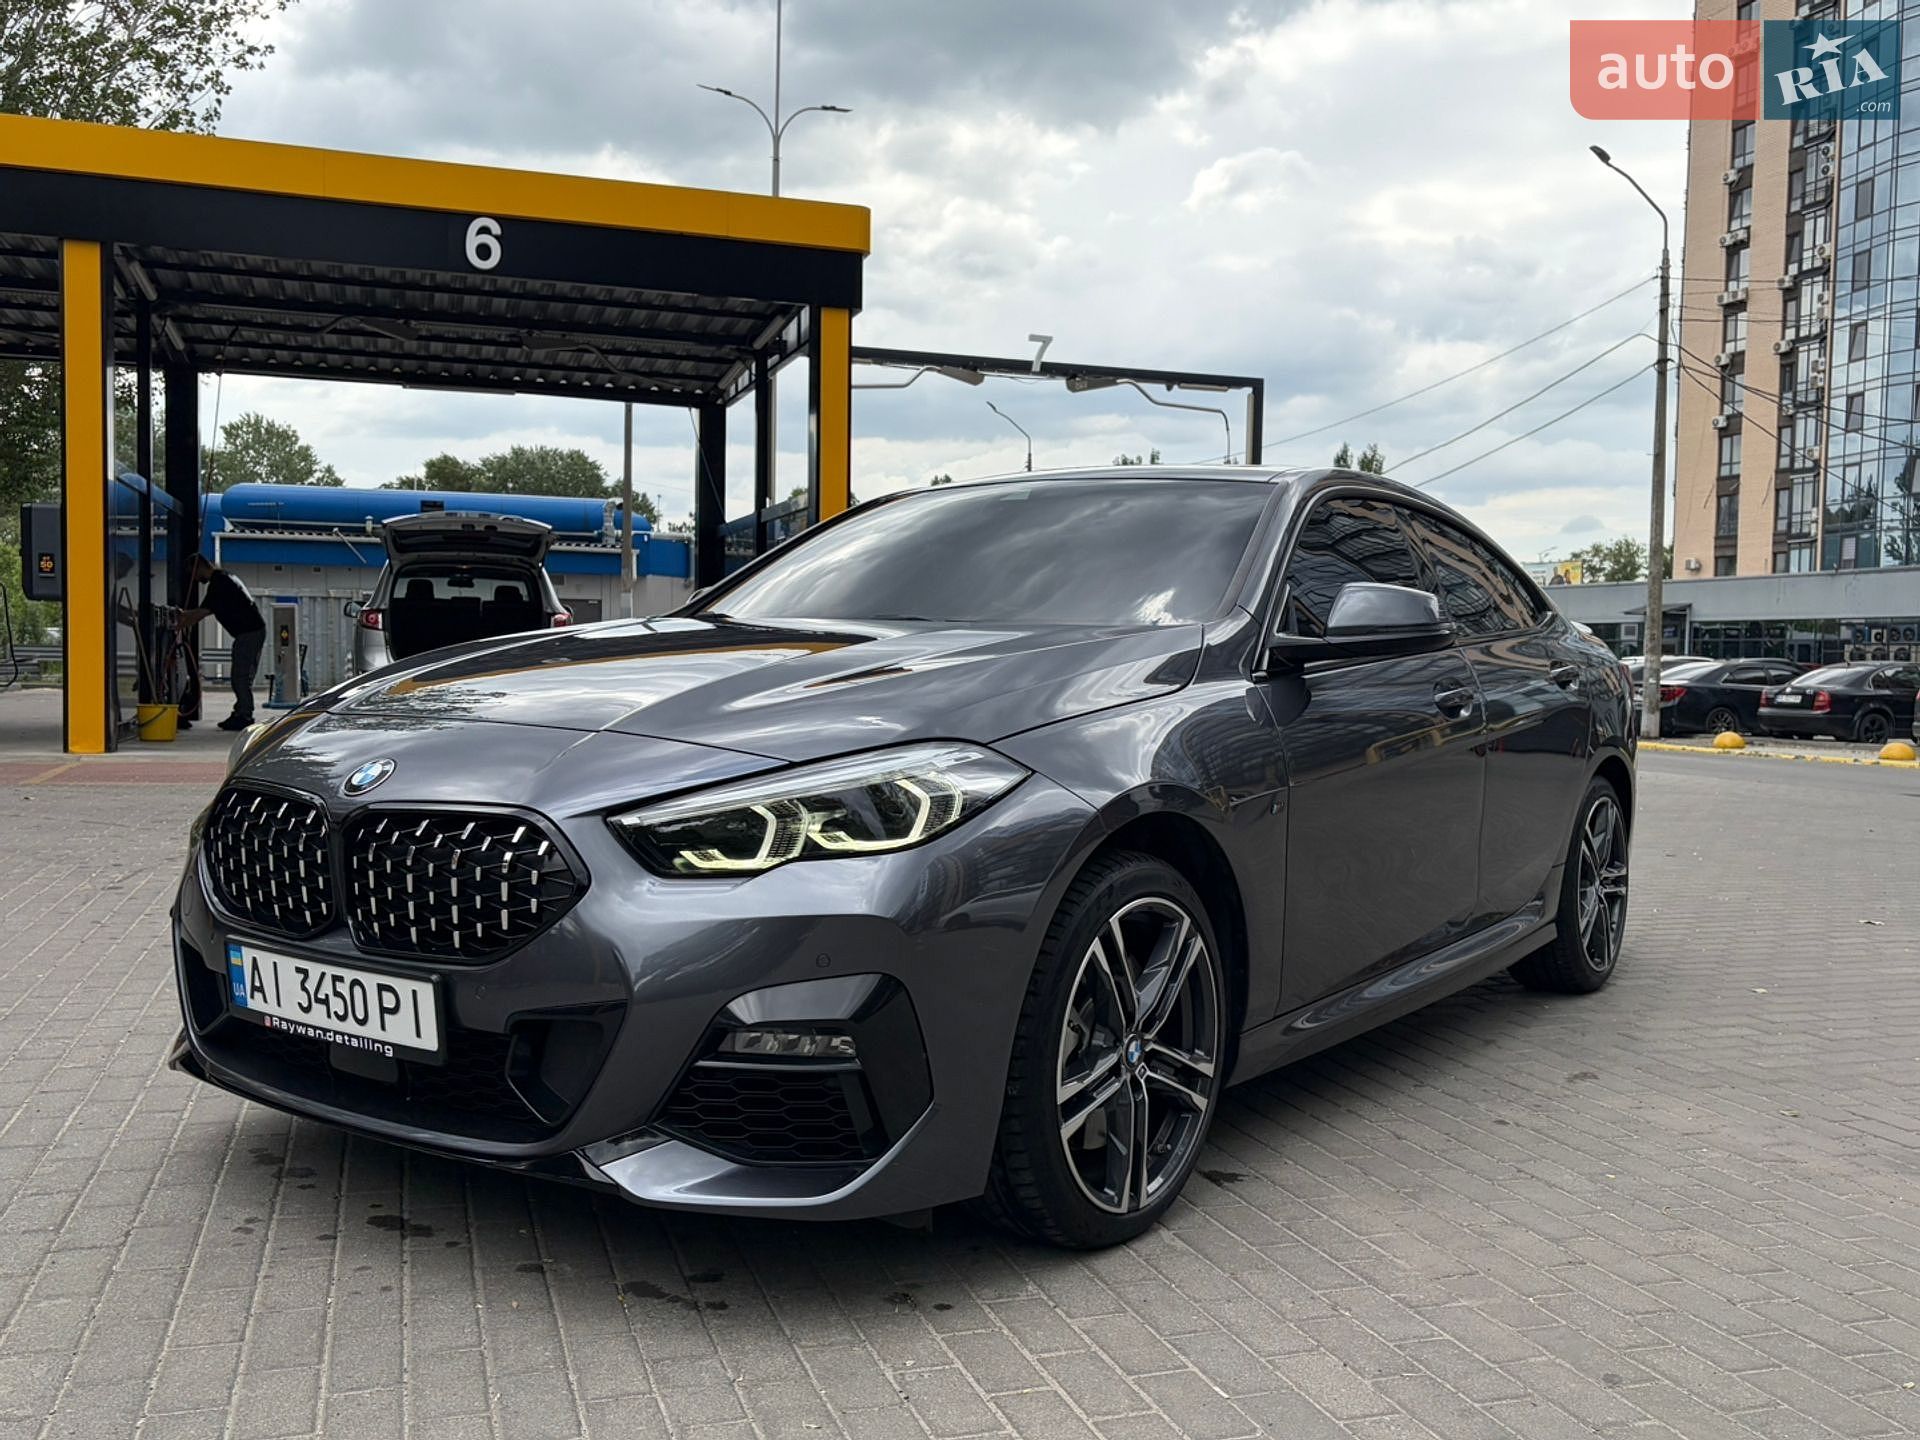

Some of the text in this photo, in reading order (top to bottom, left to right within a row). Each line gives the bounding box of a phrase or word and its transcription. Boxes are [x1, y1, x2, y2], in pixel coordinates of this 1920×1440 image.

[465, 216, 502, 270] 6
[1028, 334, 1053, 372] 7
[233, 983, 246, 997] UA
[249, 956, 422, 1039] AI 3450 PI
[272, 1017, 394, 1057] Raywan.detailing
